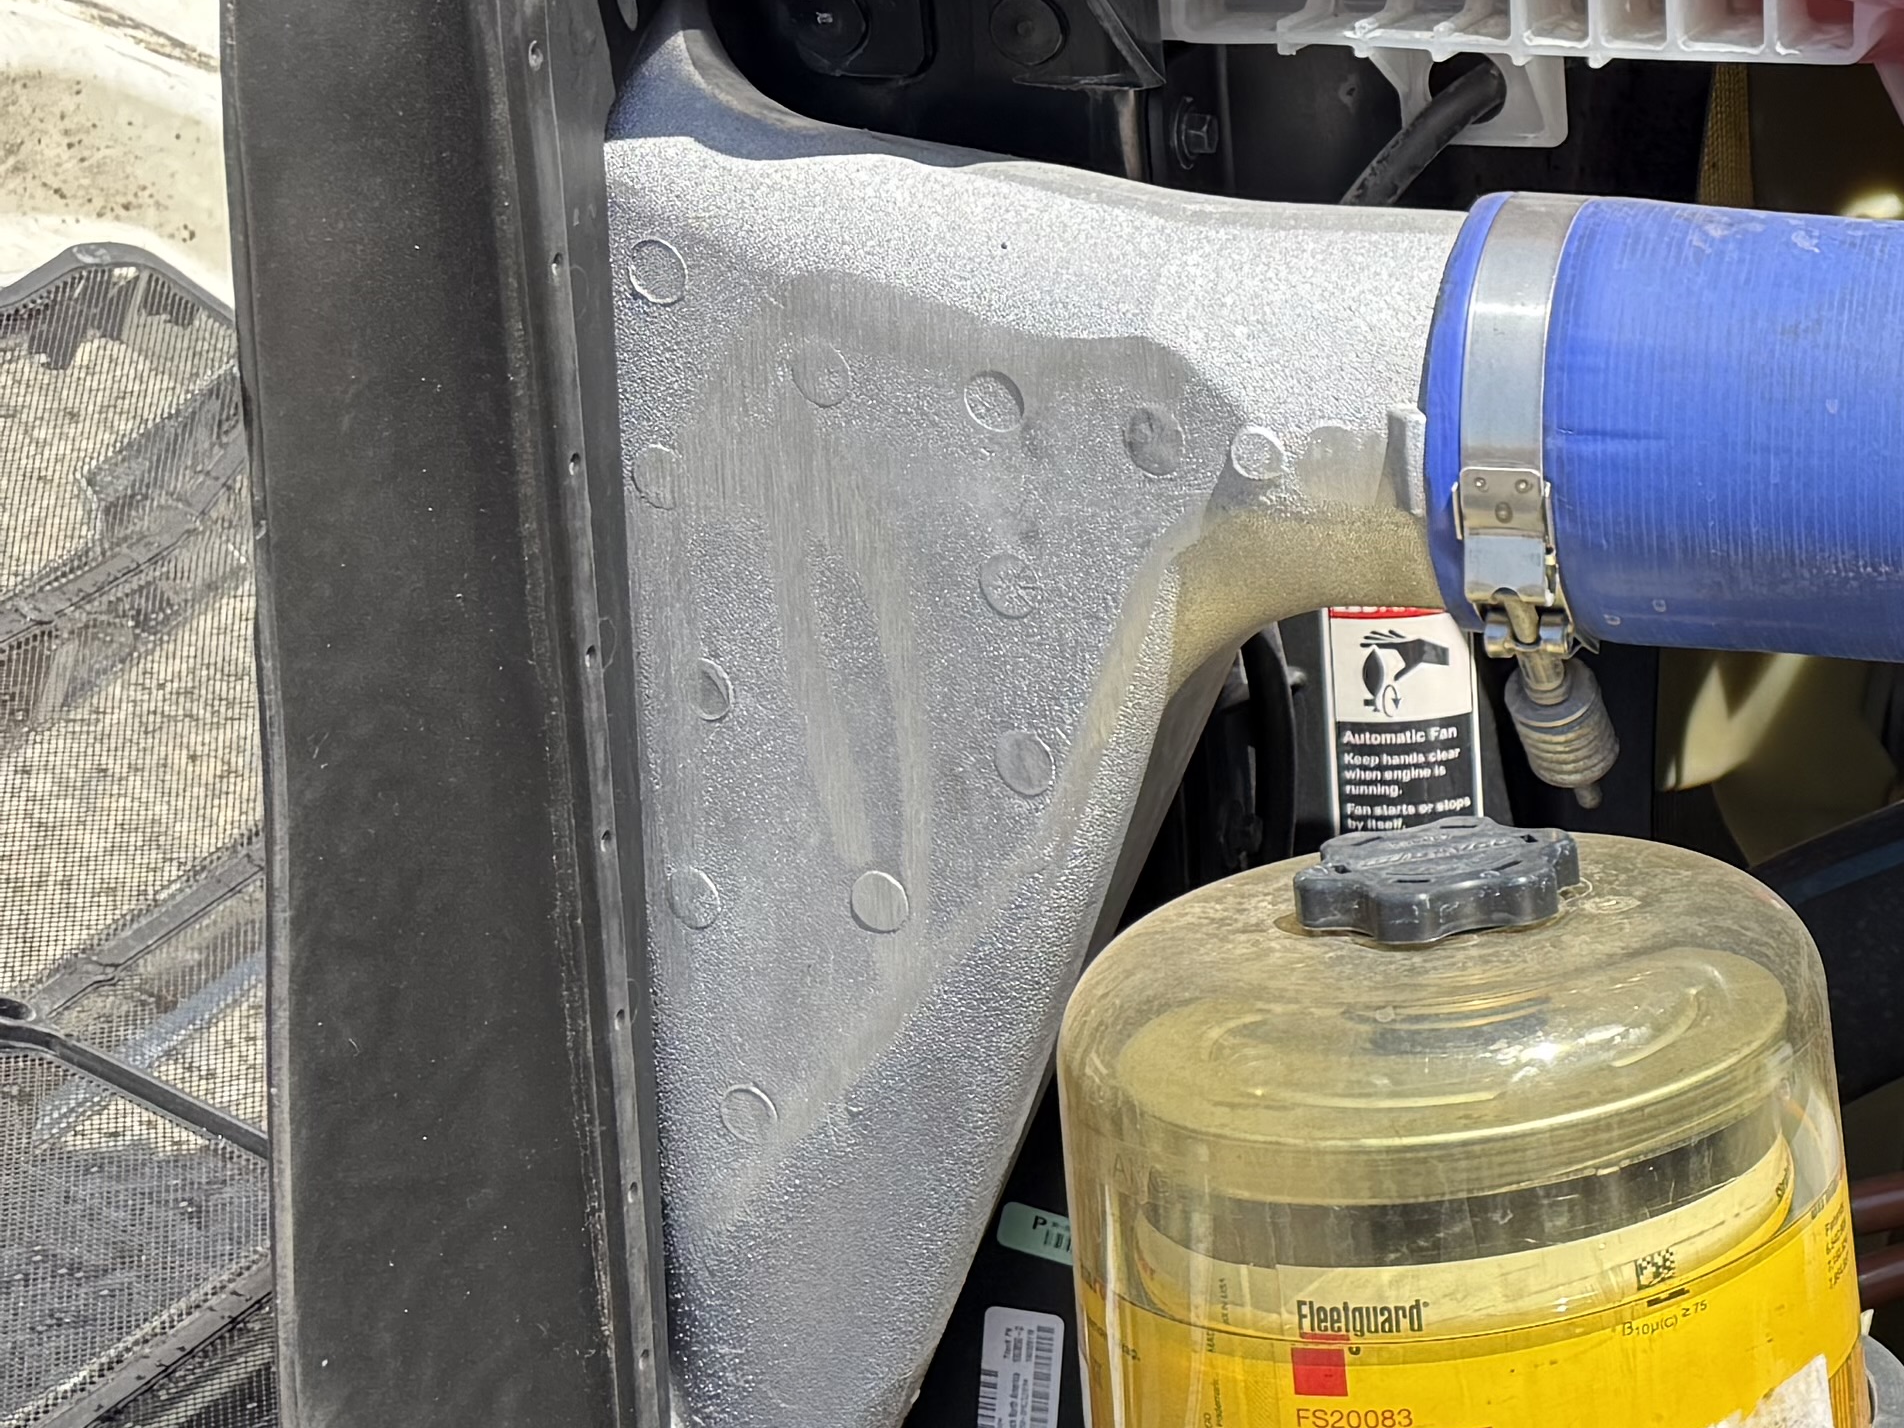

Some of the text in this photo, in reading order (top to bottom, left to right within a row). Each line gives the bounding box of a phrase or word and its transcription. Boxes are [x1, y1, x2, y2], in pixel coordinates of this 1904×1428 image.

[1343, 726, 1458, 745] Automatic Fan
[1343, 747, 1461, 766] Keep hands clear
[1344, 765, 1446, 783] when engine is
[1345, 784, 1402, 797] running.
[1347, 797, 1471, 815] Fan starts or stops
[1347, 817, 1406, 832] by itself.
[1032, 1215, 1047, 1230] P
[1297, 1299, 1424, 1338] Fleetguard
